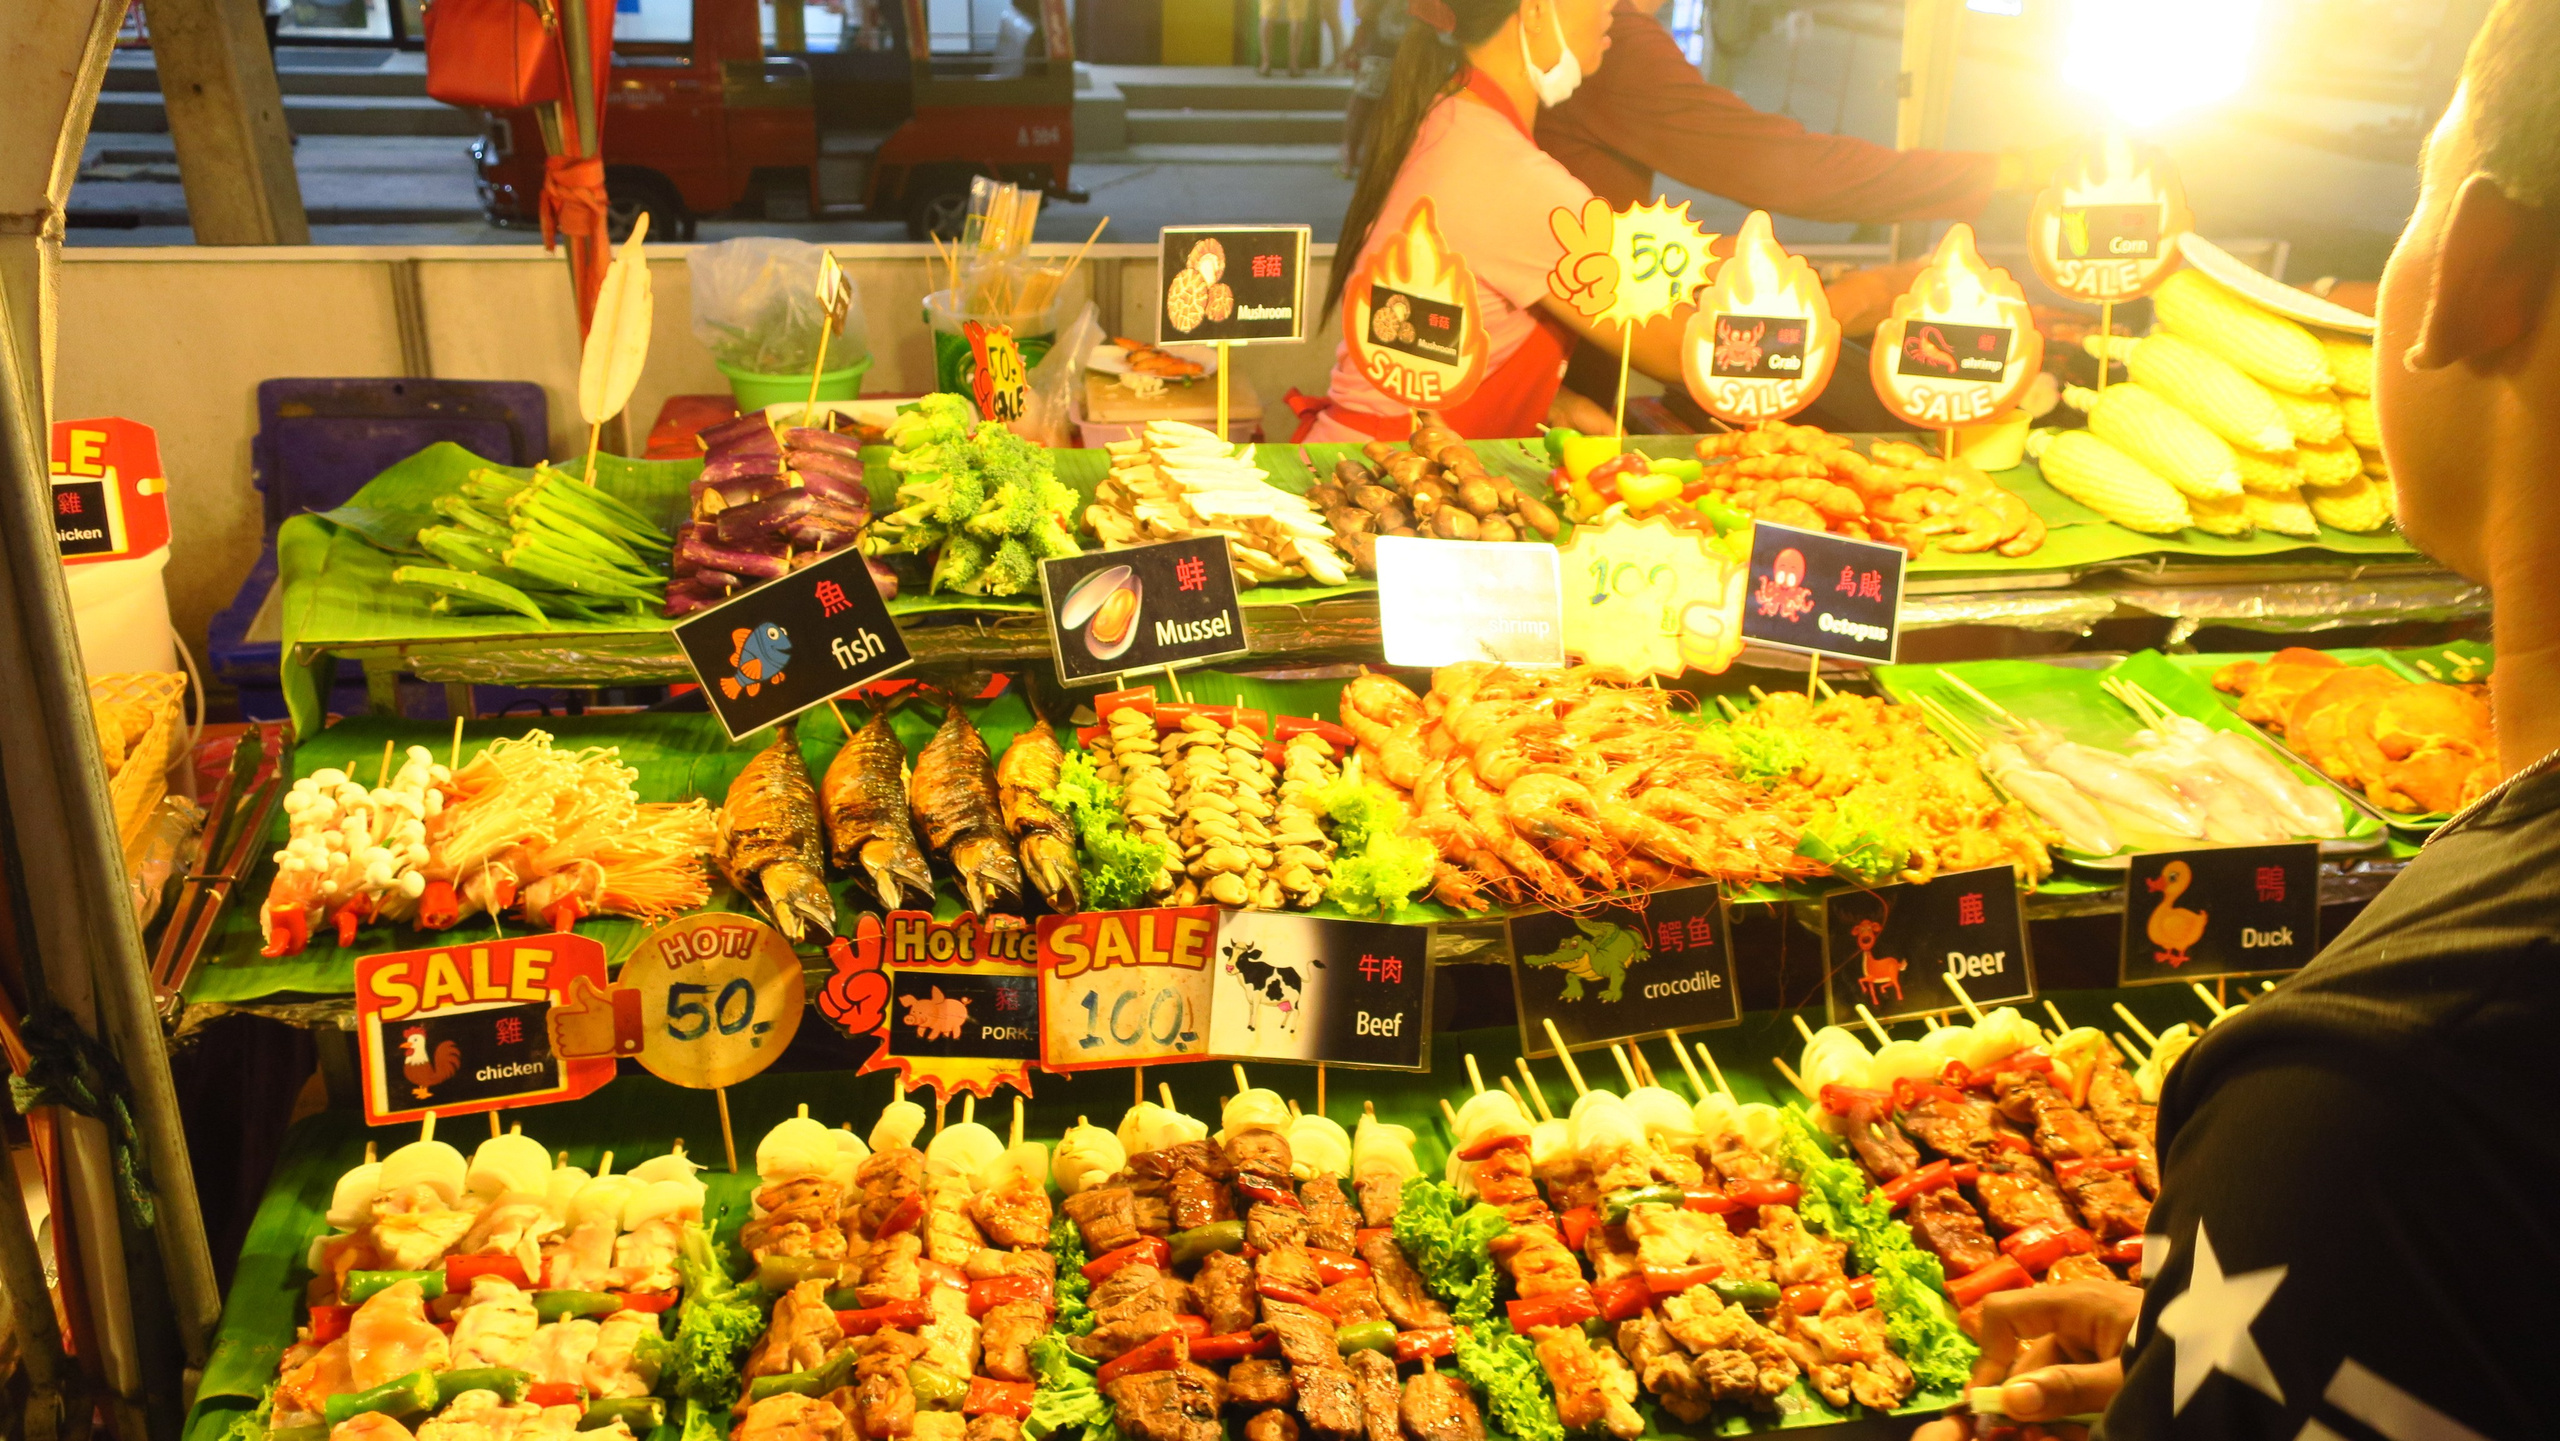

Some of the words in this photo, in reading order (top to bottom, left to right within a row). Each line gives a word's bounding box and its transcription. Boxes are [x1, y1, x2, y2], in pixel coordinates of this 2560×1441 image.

[1632, 233, 1689, 281] 50
[2109, 236, 2148, 254] Corn
[1252, 255, 1283, 278] 香菇
[2057, 259, 2142, 296] SALE
[1237, 304, 1292, 320] Mushroom
[1417, 338, 1457, 356] Mushroom
[1768, 353, 1802, 371] Crab
[1367, 352, 1441, 402] SALE
[1960, 357, 2003, 373] shrimp
[1715, 379, 1799, 417] SALE
[1903, 387, 1995, 423] SALE
[1175, 556, 1208, 592] 蚌
[1836, 565, 1882, 603] 烏賊
[815, 580, 853, 618] 魚
[1154, 609, 1232, 647] Mussel
[1488, 617, 1551, 638] shrimp
[1818, 612, 1889, 642] Octopus
[831, 627, 886, 670] fish
[1959, 892, 1986, 926] 鹿
[659, 926, 757, 968] HOT!
[894, 919, 975, 961] Hot
[1050, 915, 1211, 977] SALE
[1658, 916, 1714, 953] 鳄鱼
[2241, 926, 2293, 948] Duck
[1358, 954, 1402, 984] 牛肉
[1947, 951, 2006, 980] Deer
[370, 948, 553, 1020] SALE
[1644, 970, 1721, 999] crocodile
[496, 1017, 523, 1045] 雞
[1356, 1010, 1403, 1037] Beef
[475, 1060, 544, 1082] chicken
